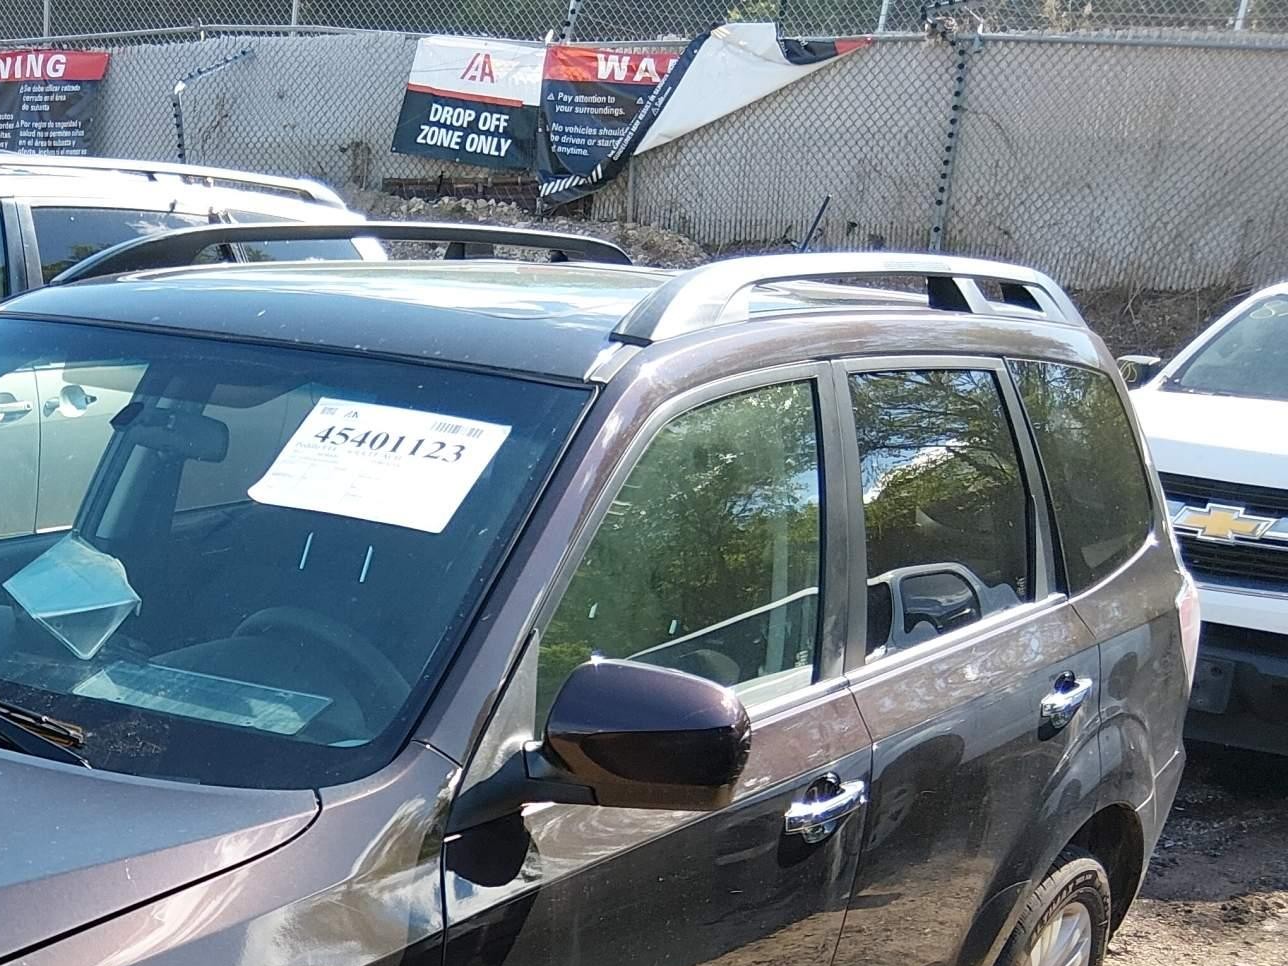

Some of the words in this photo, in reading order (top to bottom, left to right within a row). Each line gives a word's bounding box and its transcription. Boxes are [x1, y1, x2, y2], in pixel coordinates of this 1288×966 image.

[557, 92, 573, 104] Pay
[574, 95, 607, 104] attention
[608, 95, 616, 104] to
[555, 103, 573, 113] your
[574, 105, 625, 117] surroundings.
[429, 103, 476, 128] DROP
[478, 112, 510, 133] OFF
[552, 122, 564, 132] No
[565, 126, 597, 135] vehicles
[416, 125, 463, 150] ZONE
[465, 133, 512, 157] ONLY
[561, 135, 586, 145] driven
[587, 138, 596, 146] or
[557, 145, 589, 156] anytime.
[313, 425, 467, 464] 45401123
